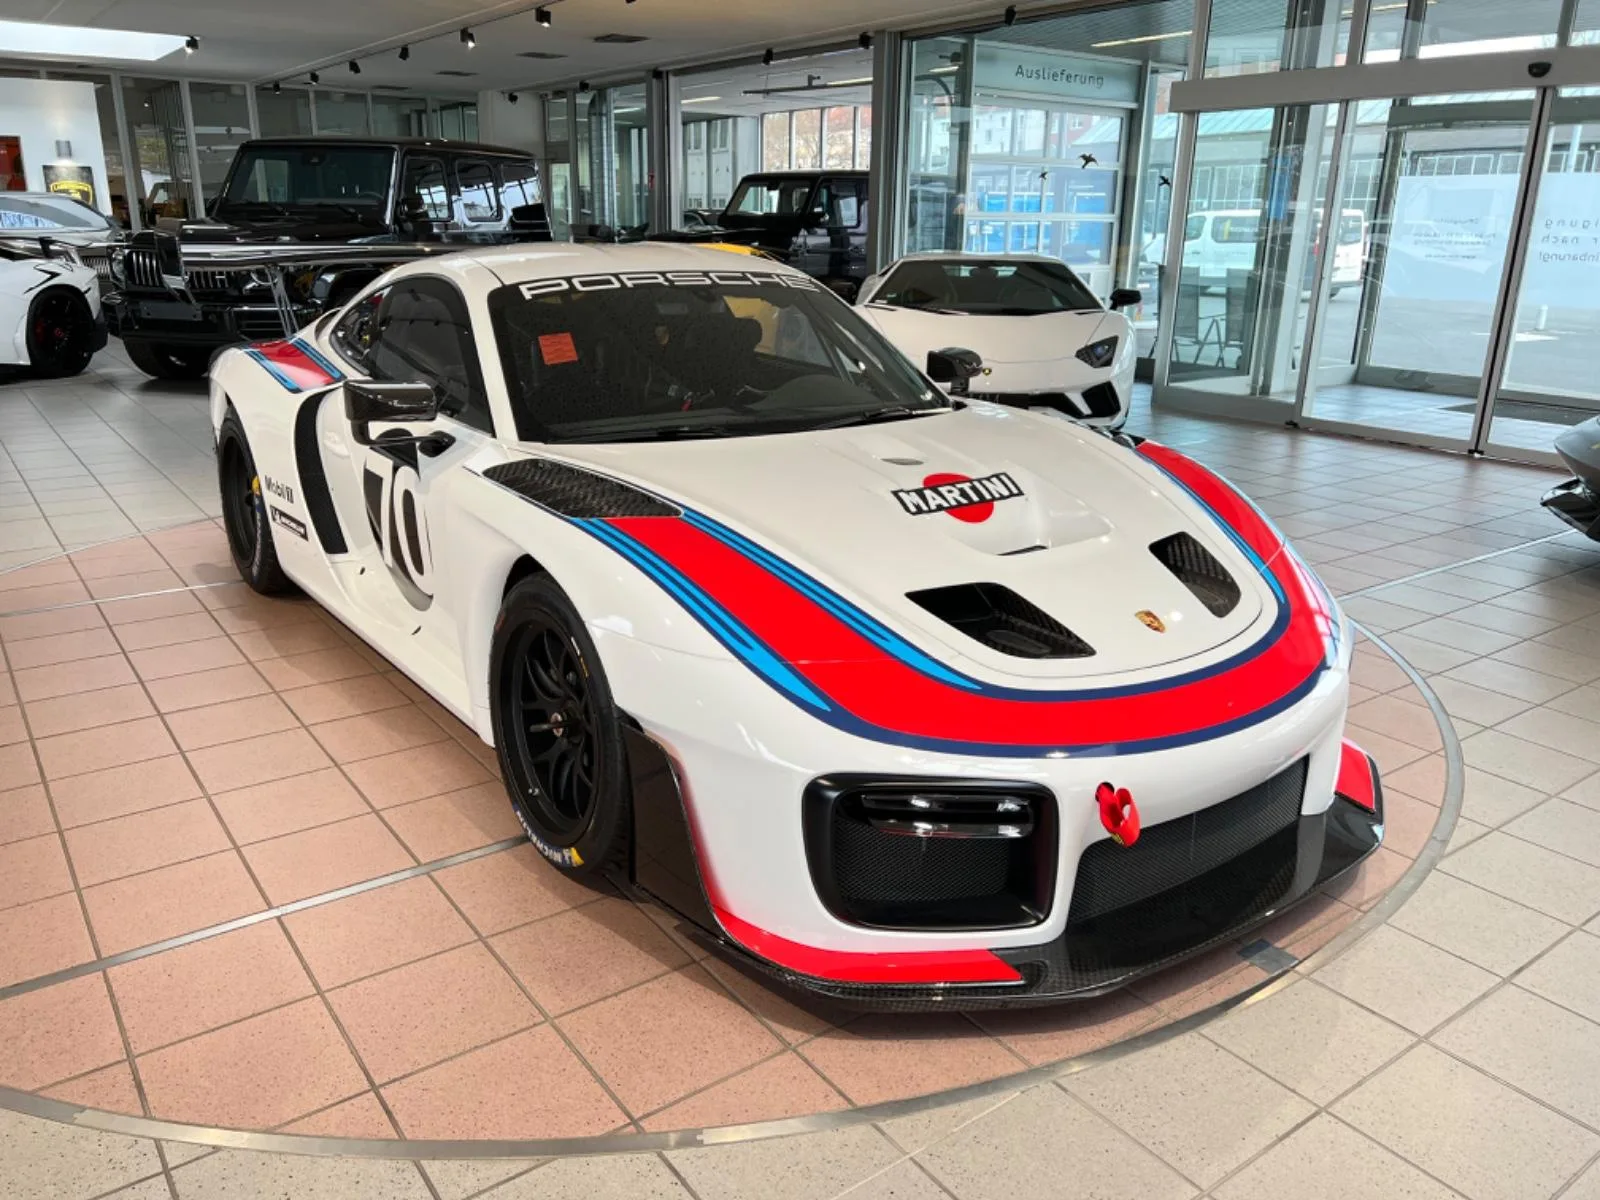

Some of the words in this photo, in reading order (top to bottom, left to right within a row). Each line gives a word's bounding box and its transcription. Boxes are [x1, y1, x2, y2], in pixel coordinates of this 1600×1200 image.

[1015, 64, 1104, 89] Auslieferung
[518, 272, 820, 300] PORSCHE
[264, 474, 286, 500] Mobil
[898, 474, 1020, 513] MARTINI
[364, 449, 434, 597] 70
